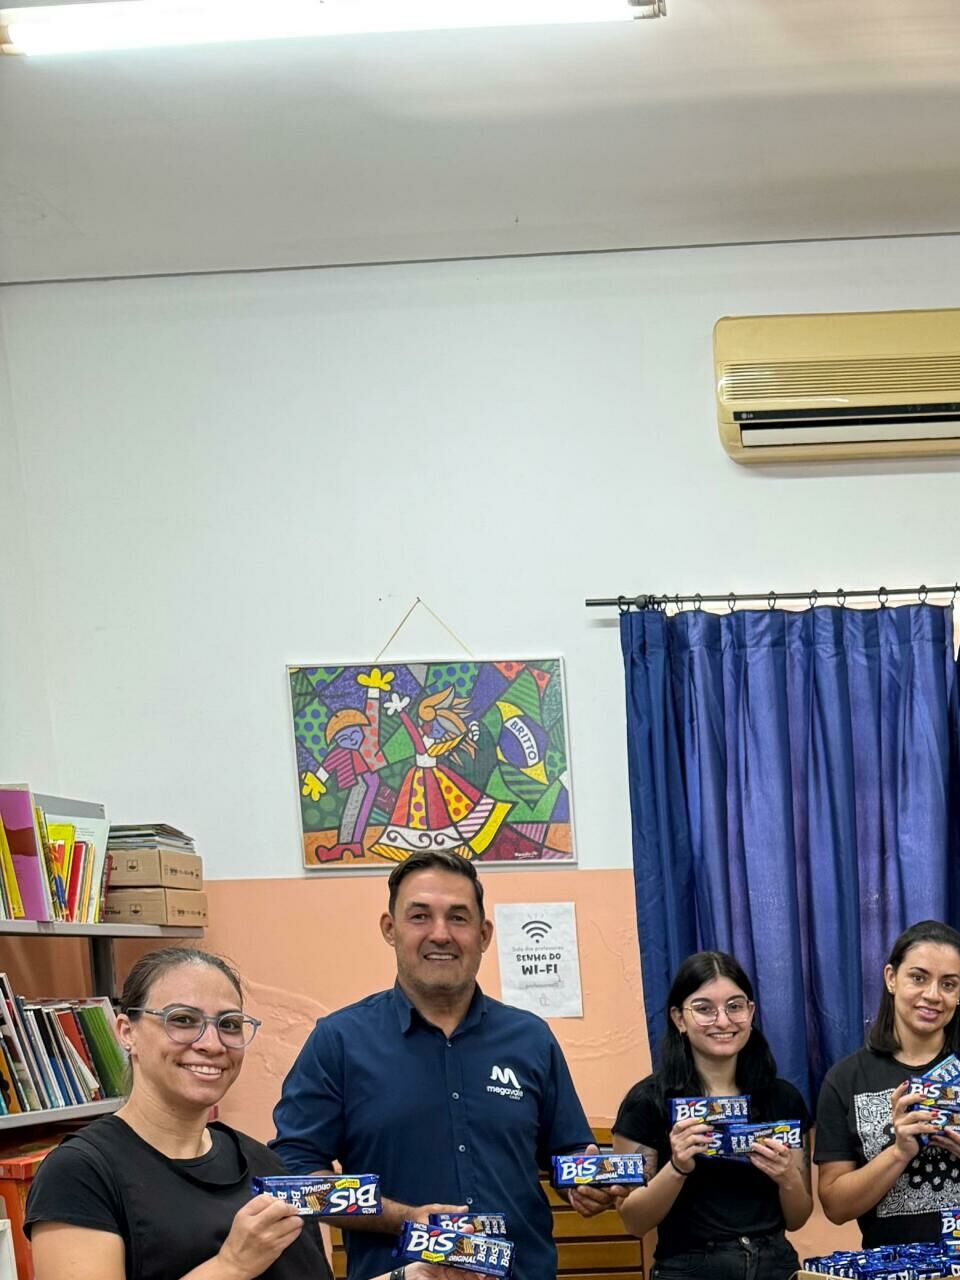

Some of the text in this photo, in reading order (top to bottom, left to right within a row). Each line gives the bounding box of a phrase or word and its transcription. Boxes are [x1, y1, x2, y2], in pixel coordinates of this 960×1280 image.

[510, 719, 538, 761] BRITTO
[549, 953, 562, 961] DO
[521, 964, 558, 975] WI-FI
[448, 1255, 477, 1263] ORIGINAL
